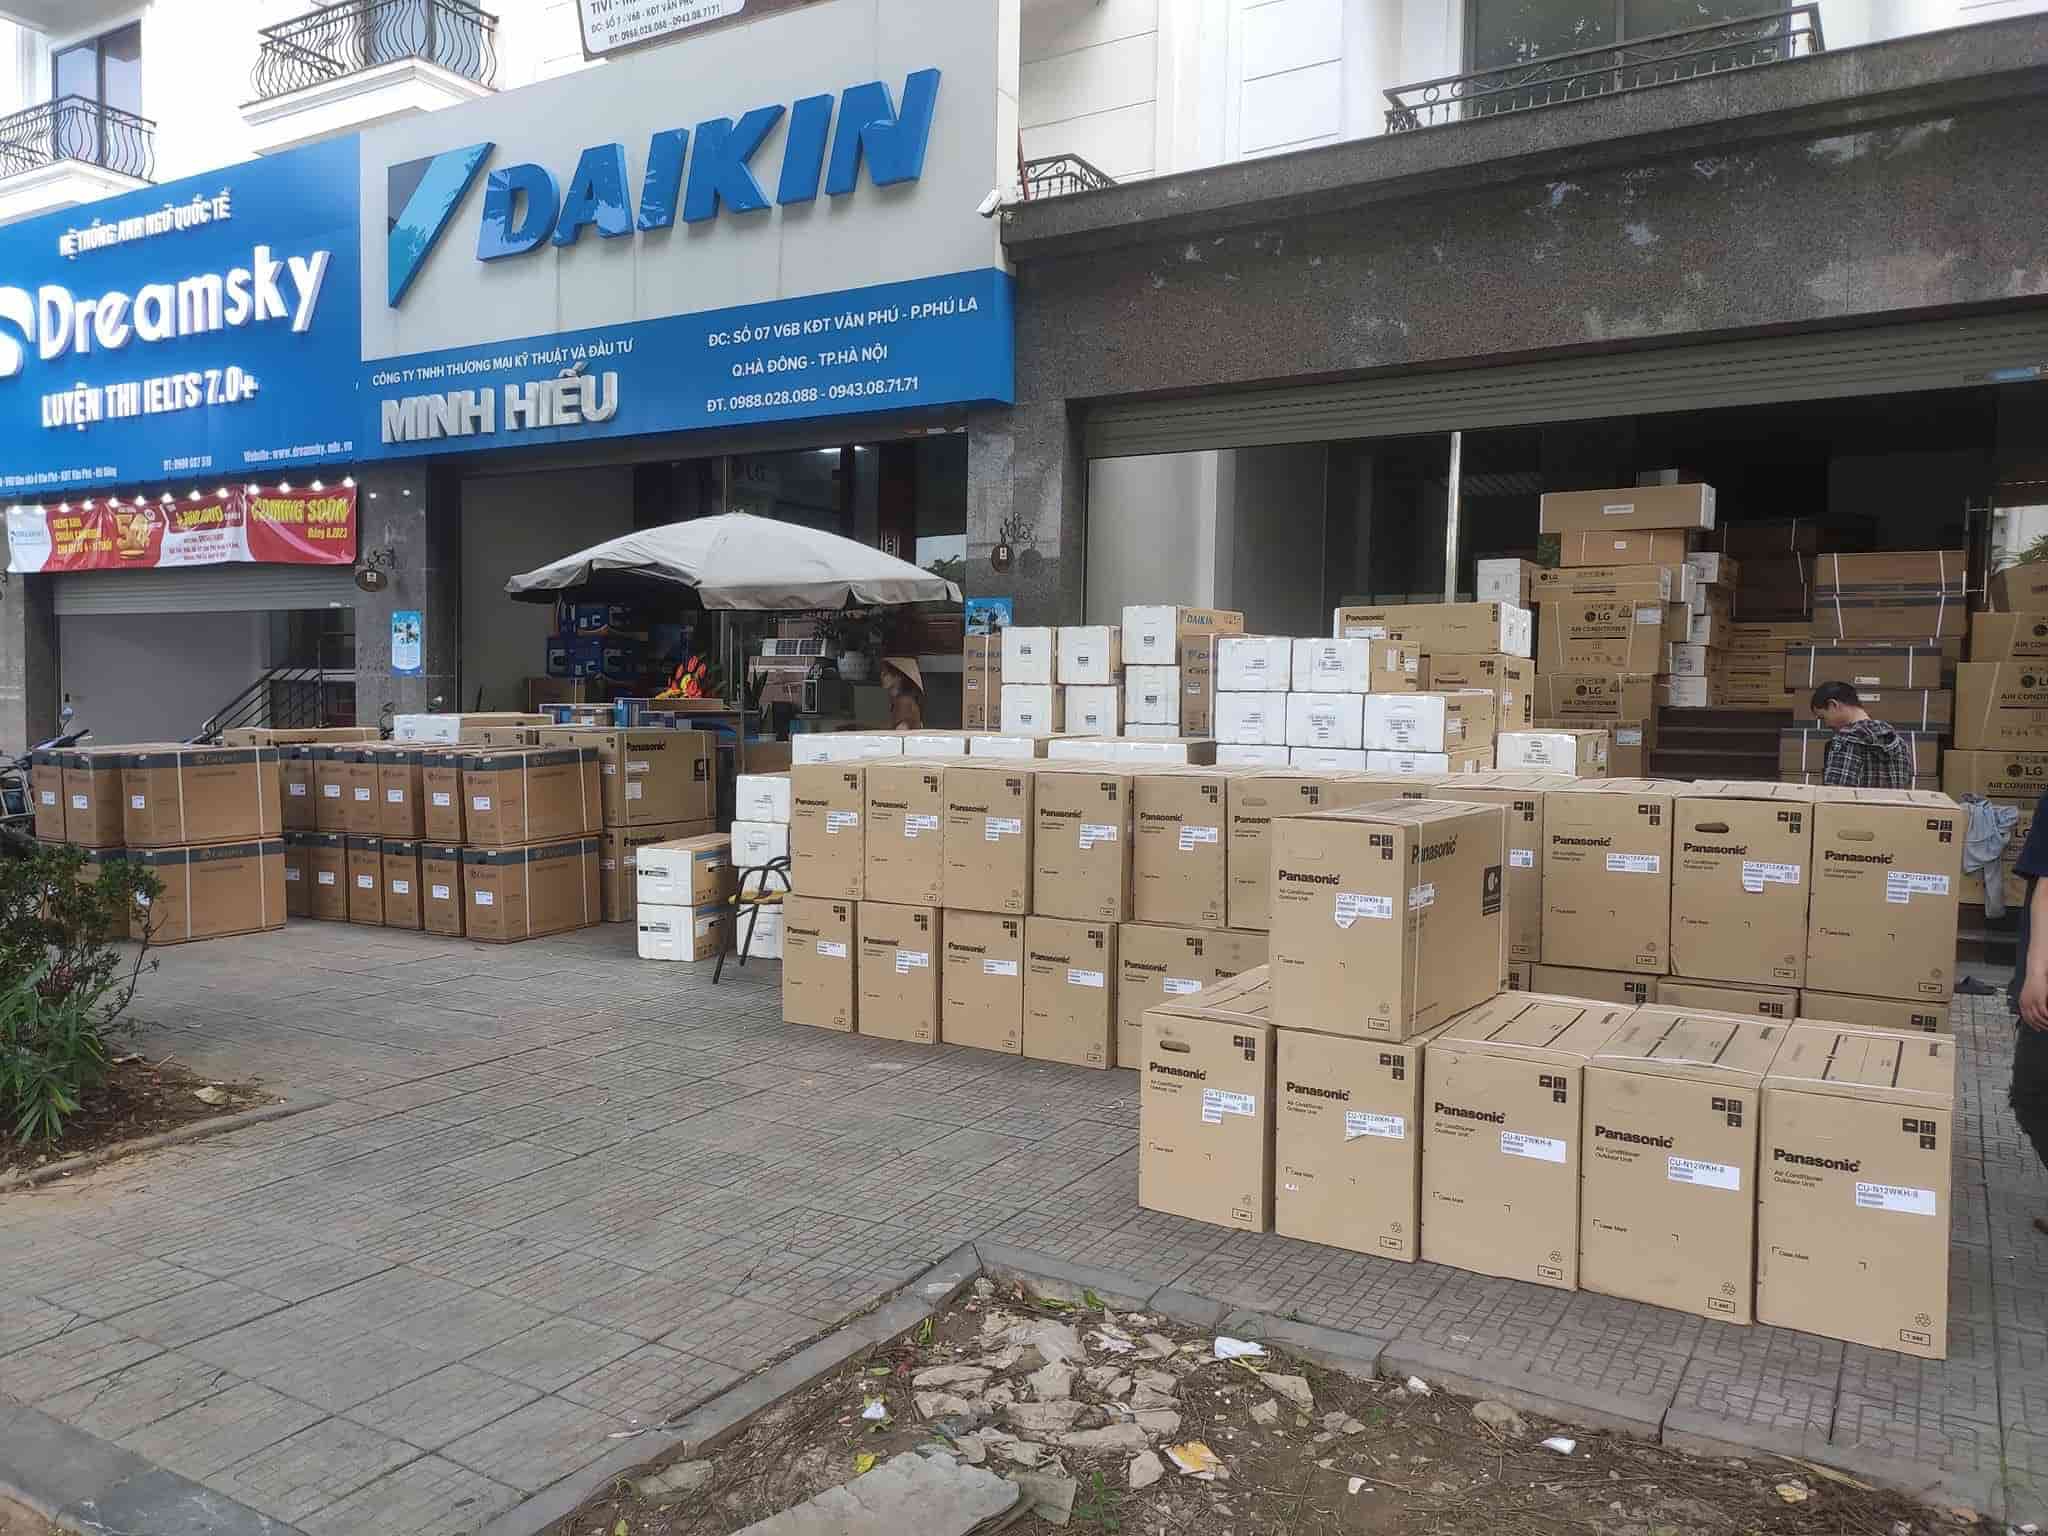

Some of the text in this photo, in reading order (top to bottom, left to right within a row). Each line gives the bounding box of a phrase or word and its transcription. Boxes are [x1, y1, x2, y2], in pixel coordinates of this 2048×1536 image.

[477, 67, 941, 263] DAIKIN
[38, 245, 332, 360] Dreamsky
[708, 332, 731, 347] ĐC:
[732, 322, 751, 345] SỐ
[753, 325, 771, 341] 07
[773, 321, 801, 339] V6B
[803, 317, 831, 335] KĐT
[834, 312, 864, 331] VĂN
[867, 304, 899, 326] PHÚ
[911, 295, 954, 320] P.PHÚ
[959, 296, 978, 313] LA
[372, 336, 635, 386] CÔNG TY TNHH THƯƠNG MẠI KỸ THUẬT VÀ ĐẦU TƯ
[731, 356, 764, 378] Q.HÀ
[766, 351, 808, 374] ĐÔNG
[818, 344, 858, 368] TP.HÀ
[861, 341, 888, 364] NỘI
[41, 366, 259, 431] LUYỆN THI IELTS 7.0+
[381, 360, 618, 443] MINH HIẾU
[706, 397, 727, 413] ĐT.
[729, 386, 818, 411] 0988.028.088
[828, 375, 919, 400] 0943.08.71.71
[1597, 612, 1611, 621] LG
[2025, 766, 2043, 777] LG
[950, 803, 989, 814] Panasonic
[1040, 807, 1082, 819] Panasonic
[1140, 811, 1184, 823] Panasonic
[1411, 833, 1458, 865] Panasonic
[1553, 835, 1612, 847] Panasonic
[1683, 842, 1747, 856] Panasonic
[1825, 850, 1895, 865] Panasonic
[1279, 869, 1341, 886] Panasonic
[948, 941, 987, 954] Panasonic
[1030, 952, 1071, 964] Panasonic
[1124, 959, 1168, 973] Panasonic
[1150, 1062, 1208, 1081] Panasonic
[1286, 1081, 1351, 1102] Panasonic
[1434, 1102, 1505, 1125] Panasonic
[1595, 1125, 1674, 1149] Panasonic
[1773, 1148, 1861, 1173] Panasonic
